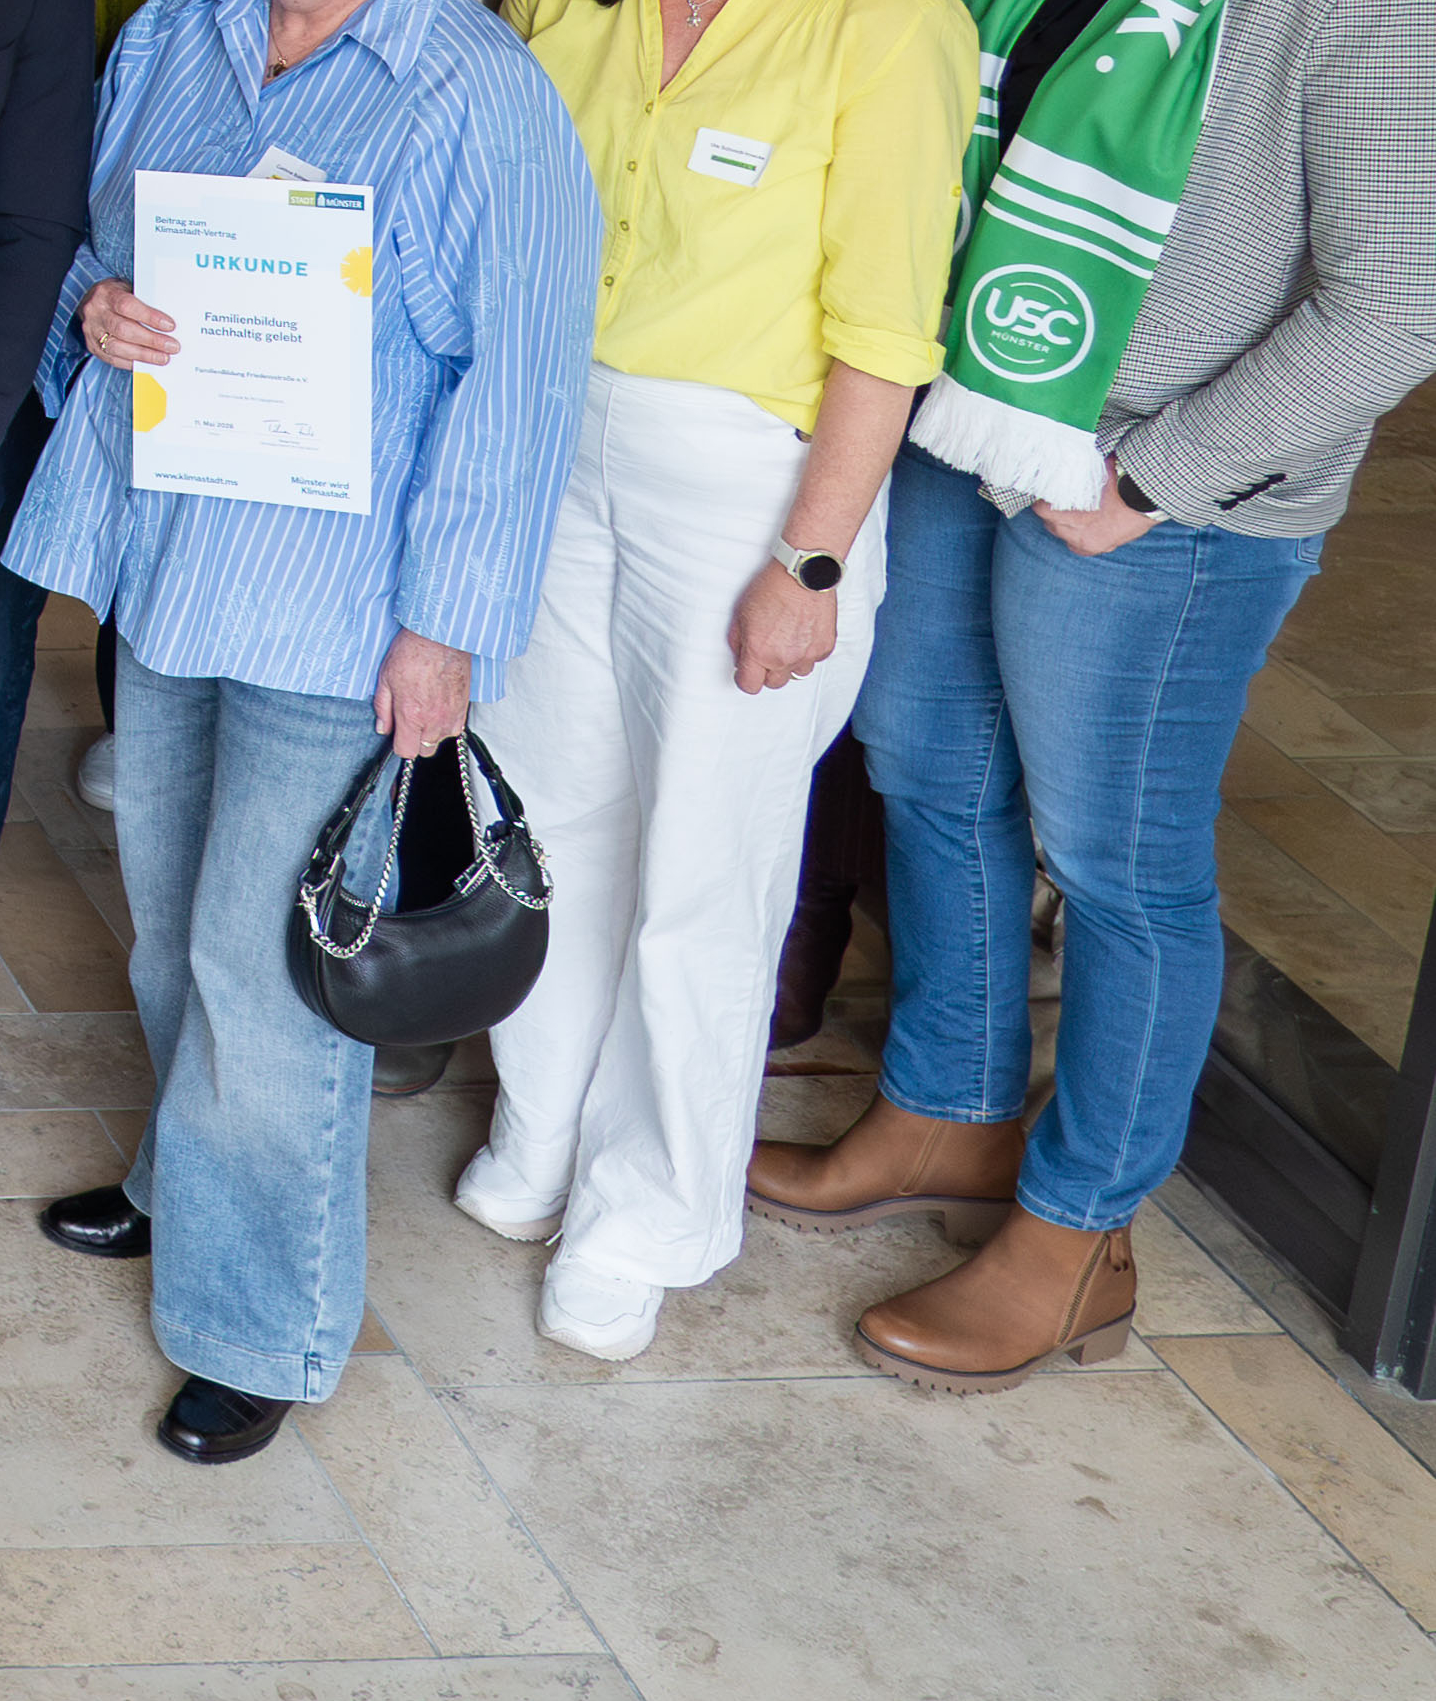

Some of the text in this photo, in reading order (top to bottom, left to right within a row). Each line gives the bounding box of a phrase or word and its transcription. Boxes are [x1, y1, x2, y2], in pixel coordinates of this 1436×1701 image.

[326, 197, 361, 208] MÜNSTER
[154, 215, 206, 227] Beitrag zum
[154, 224, 236, 239] Klimastadt-Vertrag
[195, 253, 308, 276] URKUNDE
[204, 311, 297, 331] Familienbildung
[985, 287, 1079, 345] USC
[200, 326, 302, 343] nachhaltig gelebt
[990, 330, 1050, 354] MÜNSTER
[154, 472, 238, 486] www.klimastadt.ms
[290, 475, 349, 490] Münster wird
